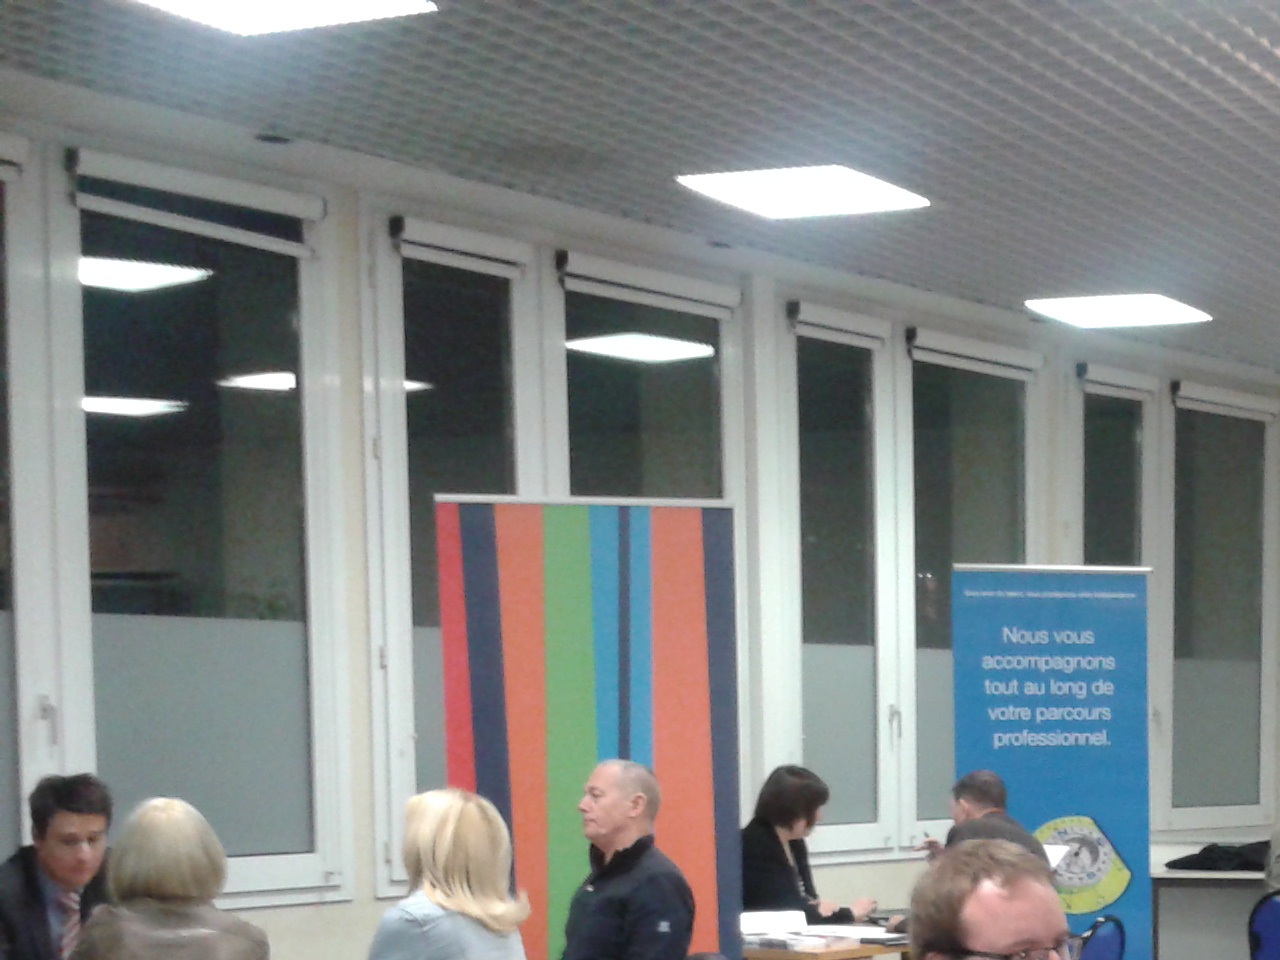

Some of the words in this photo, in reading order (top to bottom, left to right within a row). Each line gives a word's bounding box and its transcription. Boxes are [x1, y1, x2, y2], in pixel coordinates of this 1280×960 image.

[1001, 625, 1050, 645] Nous
[1053, 630, 1096, 645] vous
[981, 654, 1116, 673] accompagnons
[984, 678, 1019, 695] tout
[1023, 681, 1046, 696] au
[1049, 678, 1088, 699] long
[1091, 679, 1115, 696] de
[987, 704, 1031, 721] votre
[1035, 705, 1112, 724] parcours
[992, 728, 1112, 750] professionnel.
